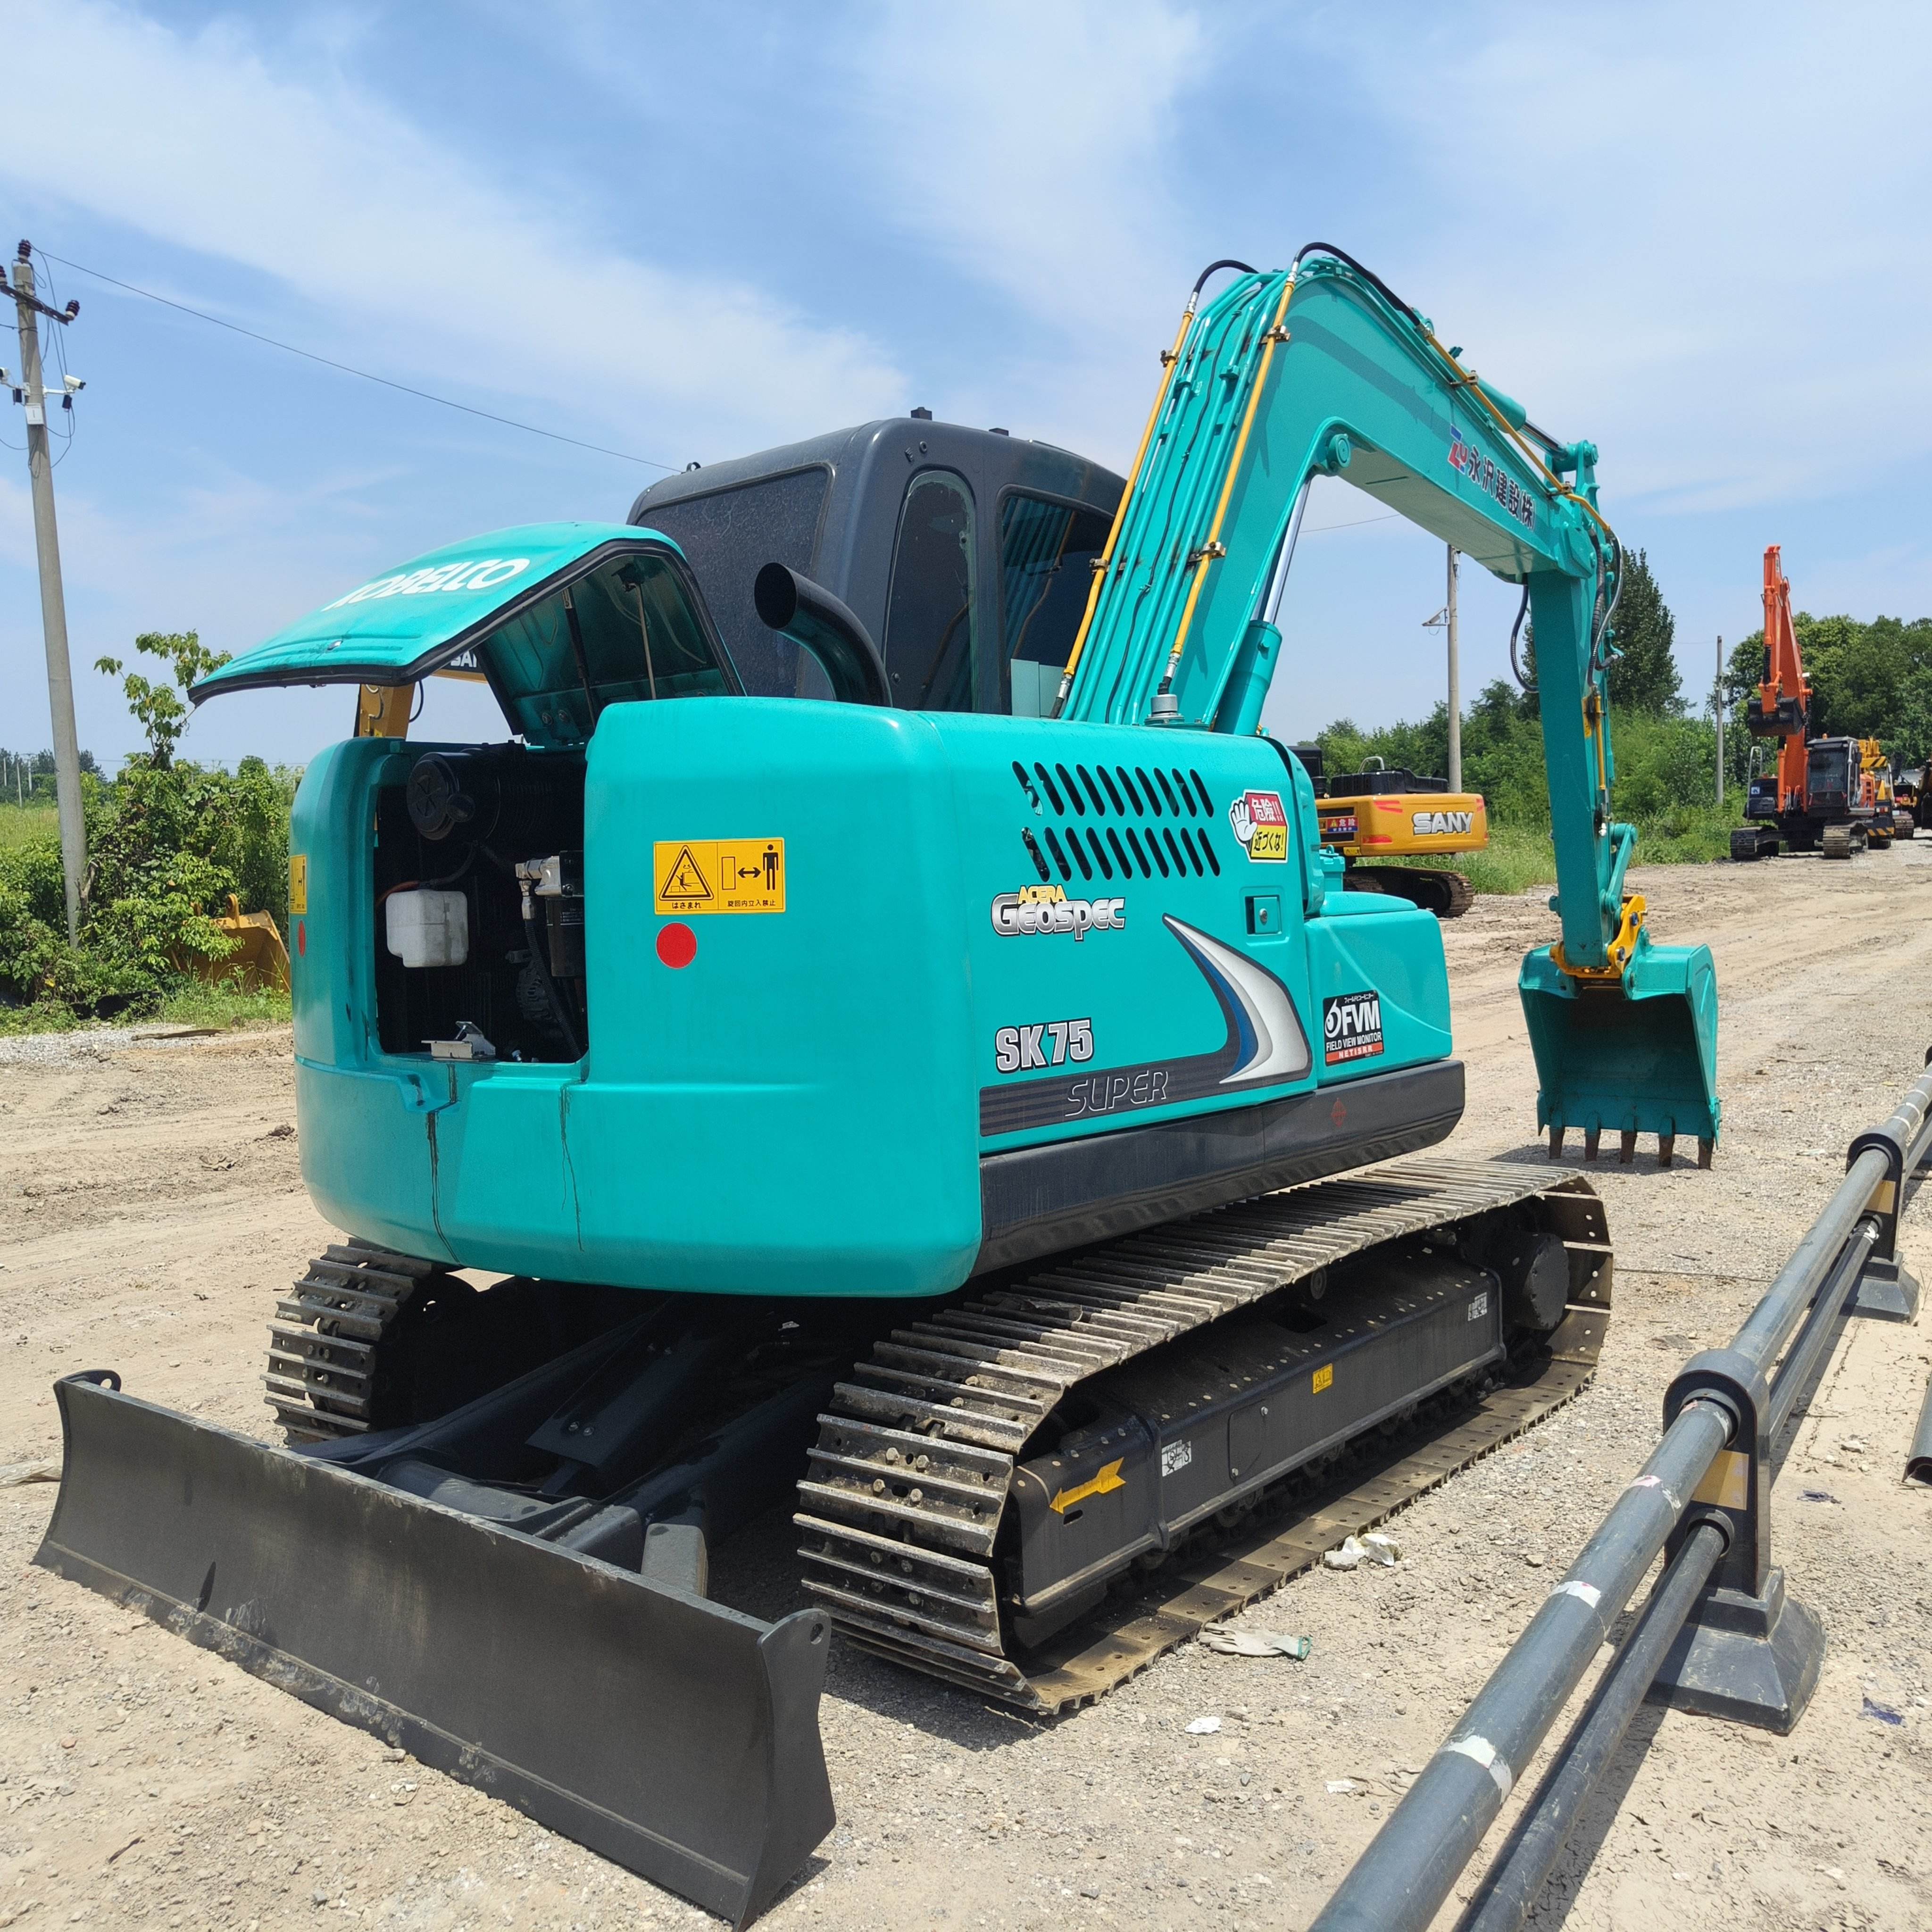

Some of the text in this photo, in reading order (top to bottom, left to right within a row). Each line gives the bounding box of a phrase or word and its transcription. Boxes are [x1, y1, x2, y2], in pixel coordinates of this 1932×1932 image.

[1412, 811, 1474, 835] SANY
[672, 901, 701, 909] はさまれ
[1017, 884, 1067, 904] ACERA
[995, 1017, 1094, 1074] SK75
[1326, 1032, 1382, 1052] FIELD VIEW MONITOR
[1064, 1070, 1169, 1117] SUPER
